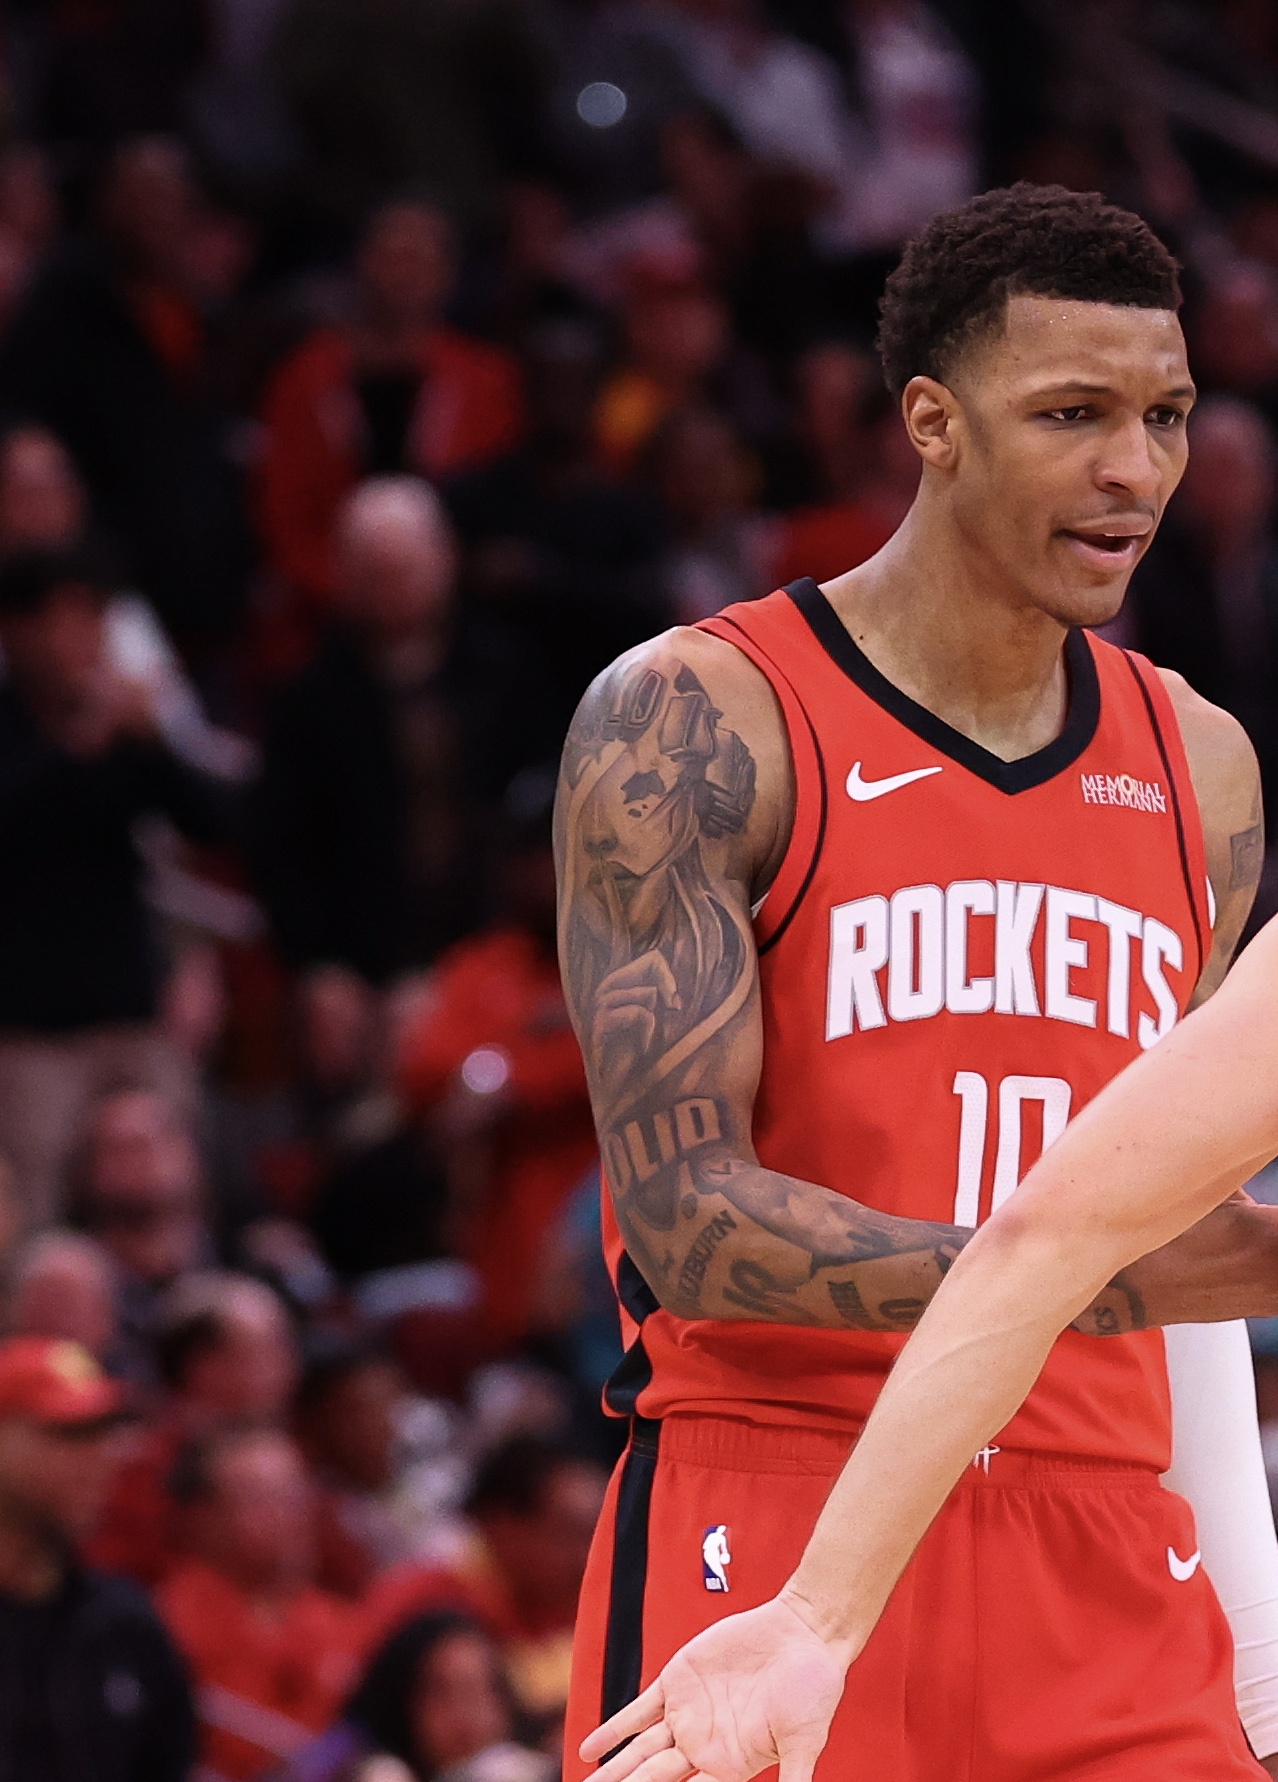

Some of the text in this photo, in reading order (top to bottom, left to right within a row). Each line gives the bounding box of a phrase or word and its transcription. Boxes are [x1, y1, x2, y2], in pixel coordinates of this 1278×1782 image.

[1080, 773, 1165, 799] MEMORIAL
[1082, 786, 1166, 813] HERMANN
[825, 879, 1183, 1051] ROCKETS
